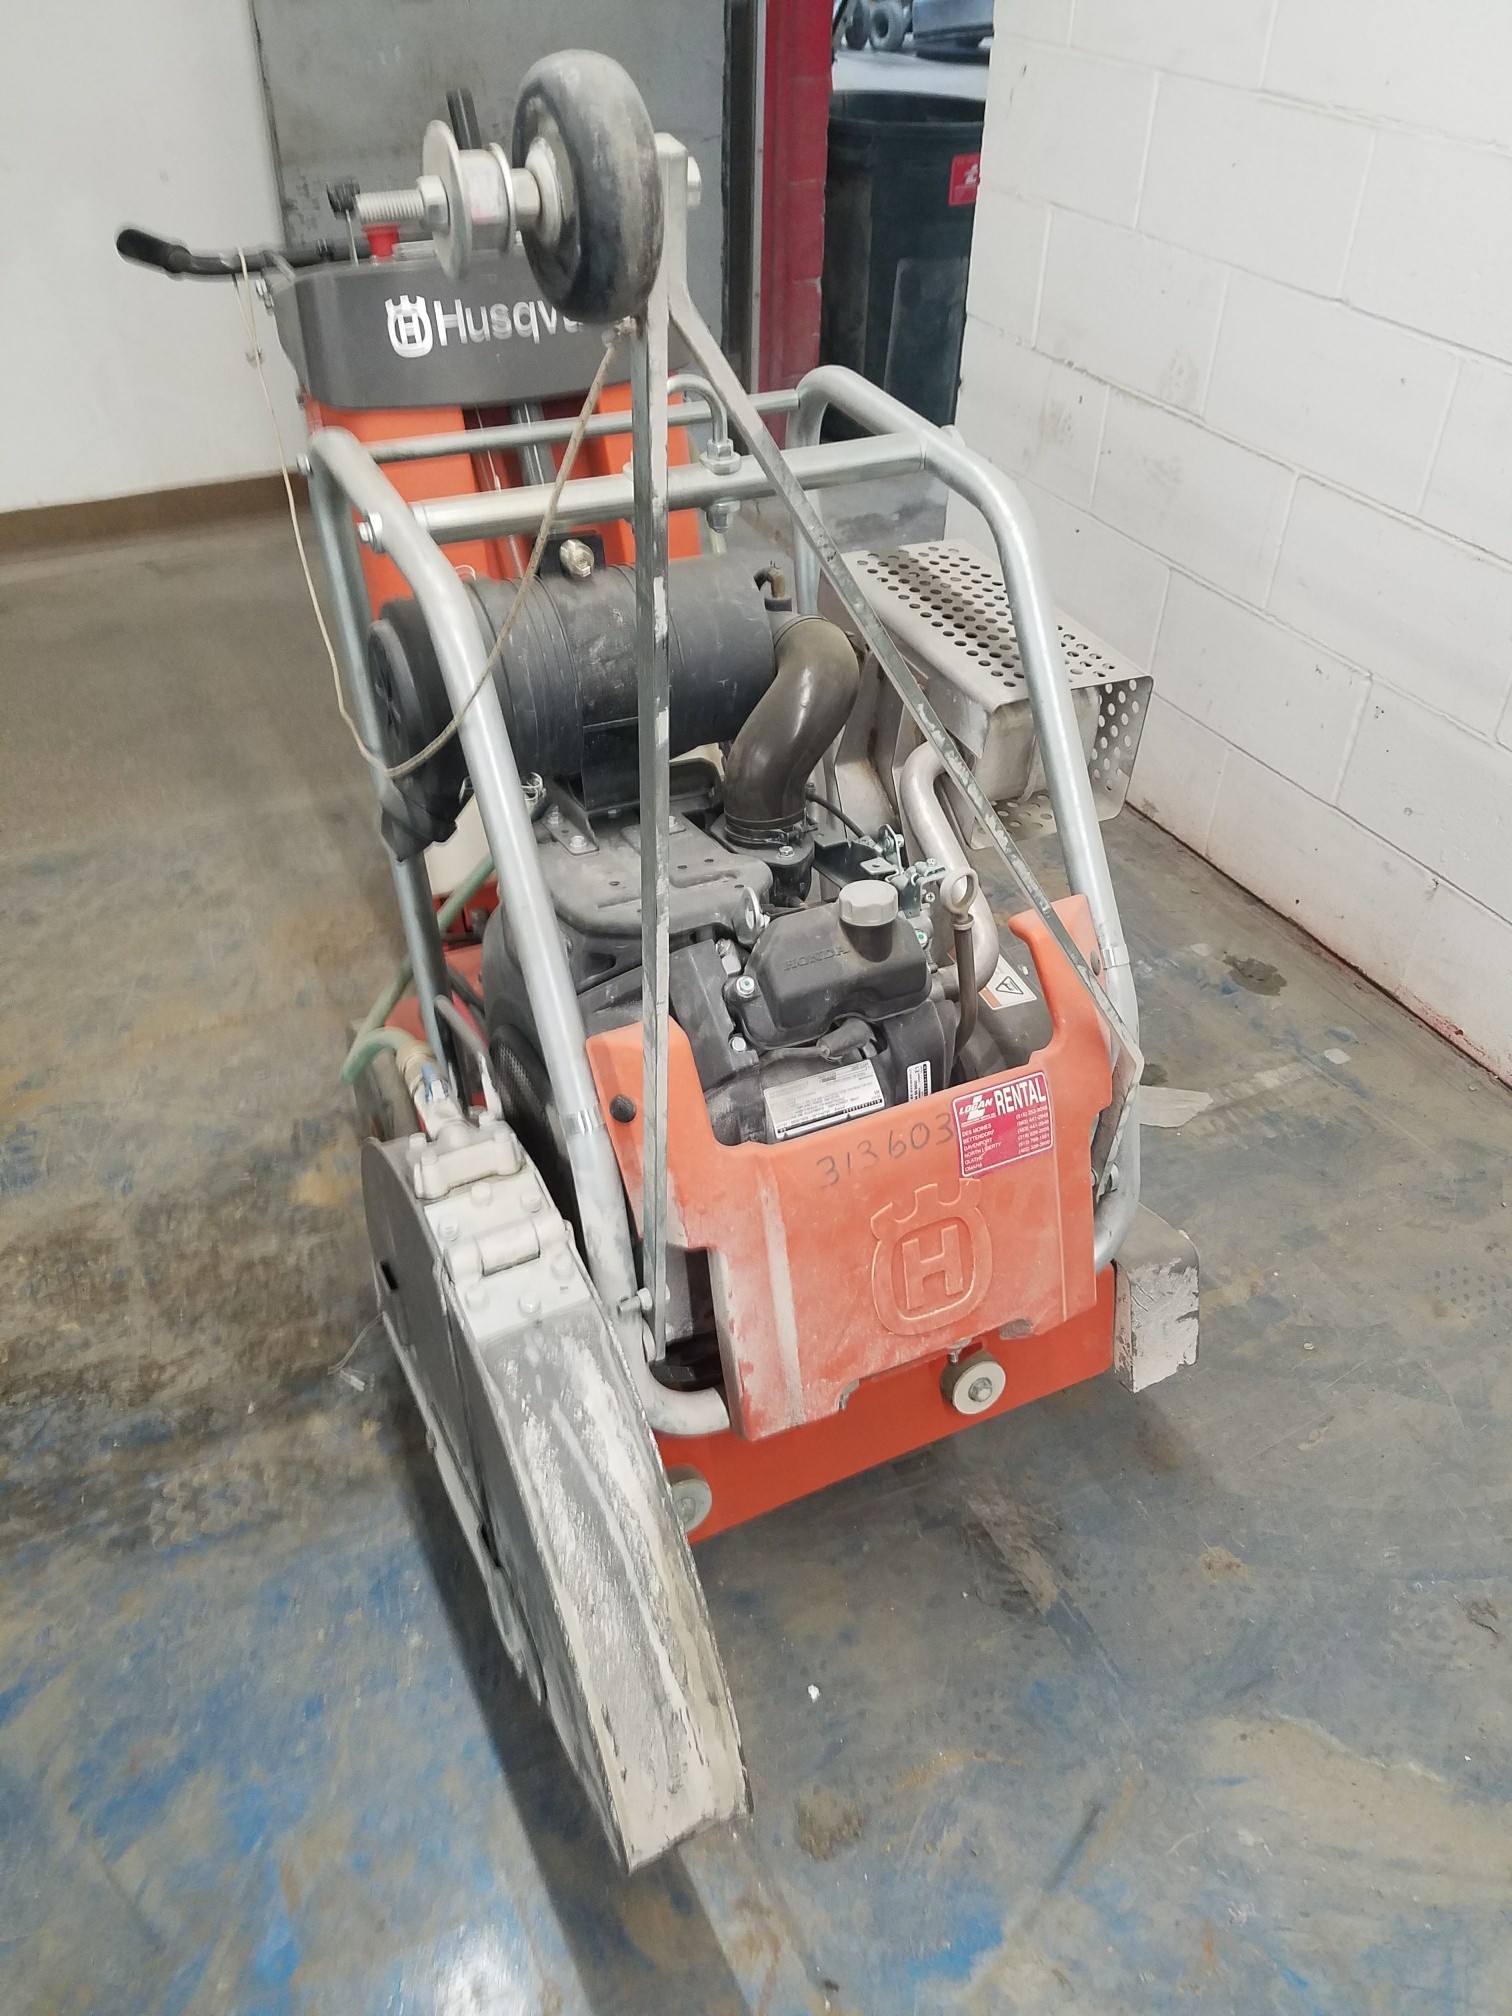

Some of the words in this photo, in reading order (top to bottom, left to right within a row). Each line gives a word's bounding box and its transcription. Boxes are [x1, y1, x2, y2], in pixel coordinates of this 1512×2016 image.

[784, 947, 850, 972] HONDA
[959, 1098, 993, 1115] LOGAN
[993, 1078, 1046, 1116] RENTAL
[962, 1128, 972, 1137] DES
[973, 1123, 992, 1135] MOINES
[963, 1130, 995, 1145] BETTENDORF
[816, 1111, 955, 1190] 313603
[964, 1138, 993, 1151] DAVENPORT
[964, 1148, 981, 1158] NORTH
[982, 1142, 1002, 1154] LIBERTY
[965, 1156, 983, 1165] OLATHE
[965, 1163, 982, 1172] OMAHA
